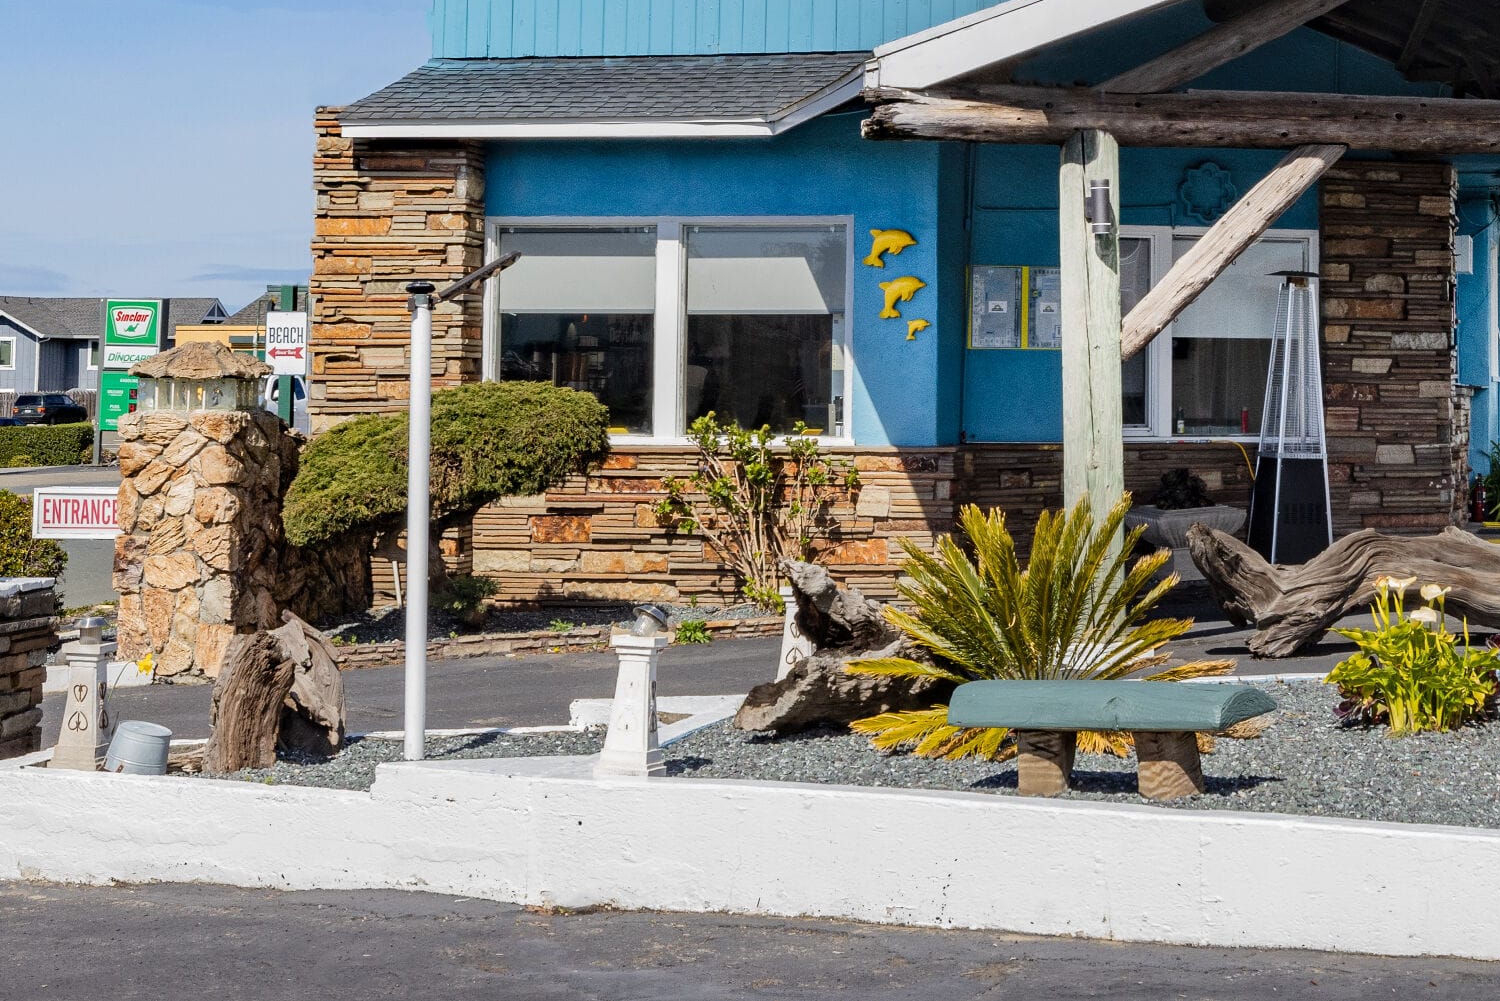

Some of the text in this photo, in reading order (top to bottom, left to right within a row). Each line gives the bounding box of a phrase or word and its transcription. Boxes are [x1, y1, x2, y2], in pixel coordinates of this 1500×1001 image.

[115, 311, 149, 322] Sinclair
[269, 326, 304, 344] BEACH
[108, 351, 152, 361] DINOCAR
